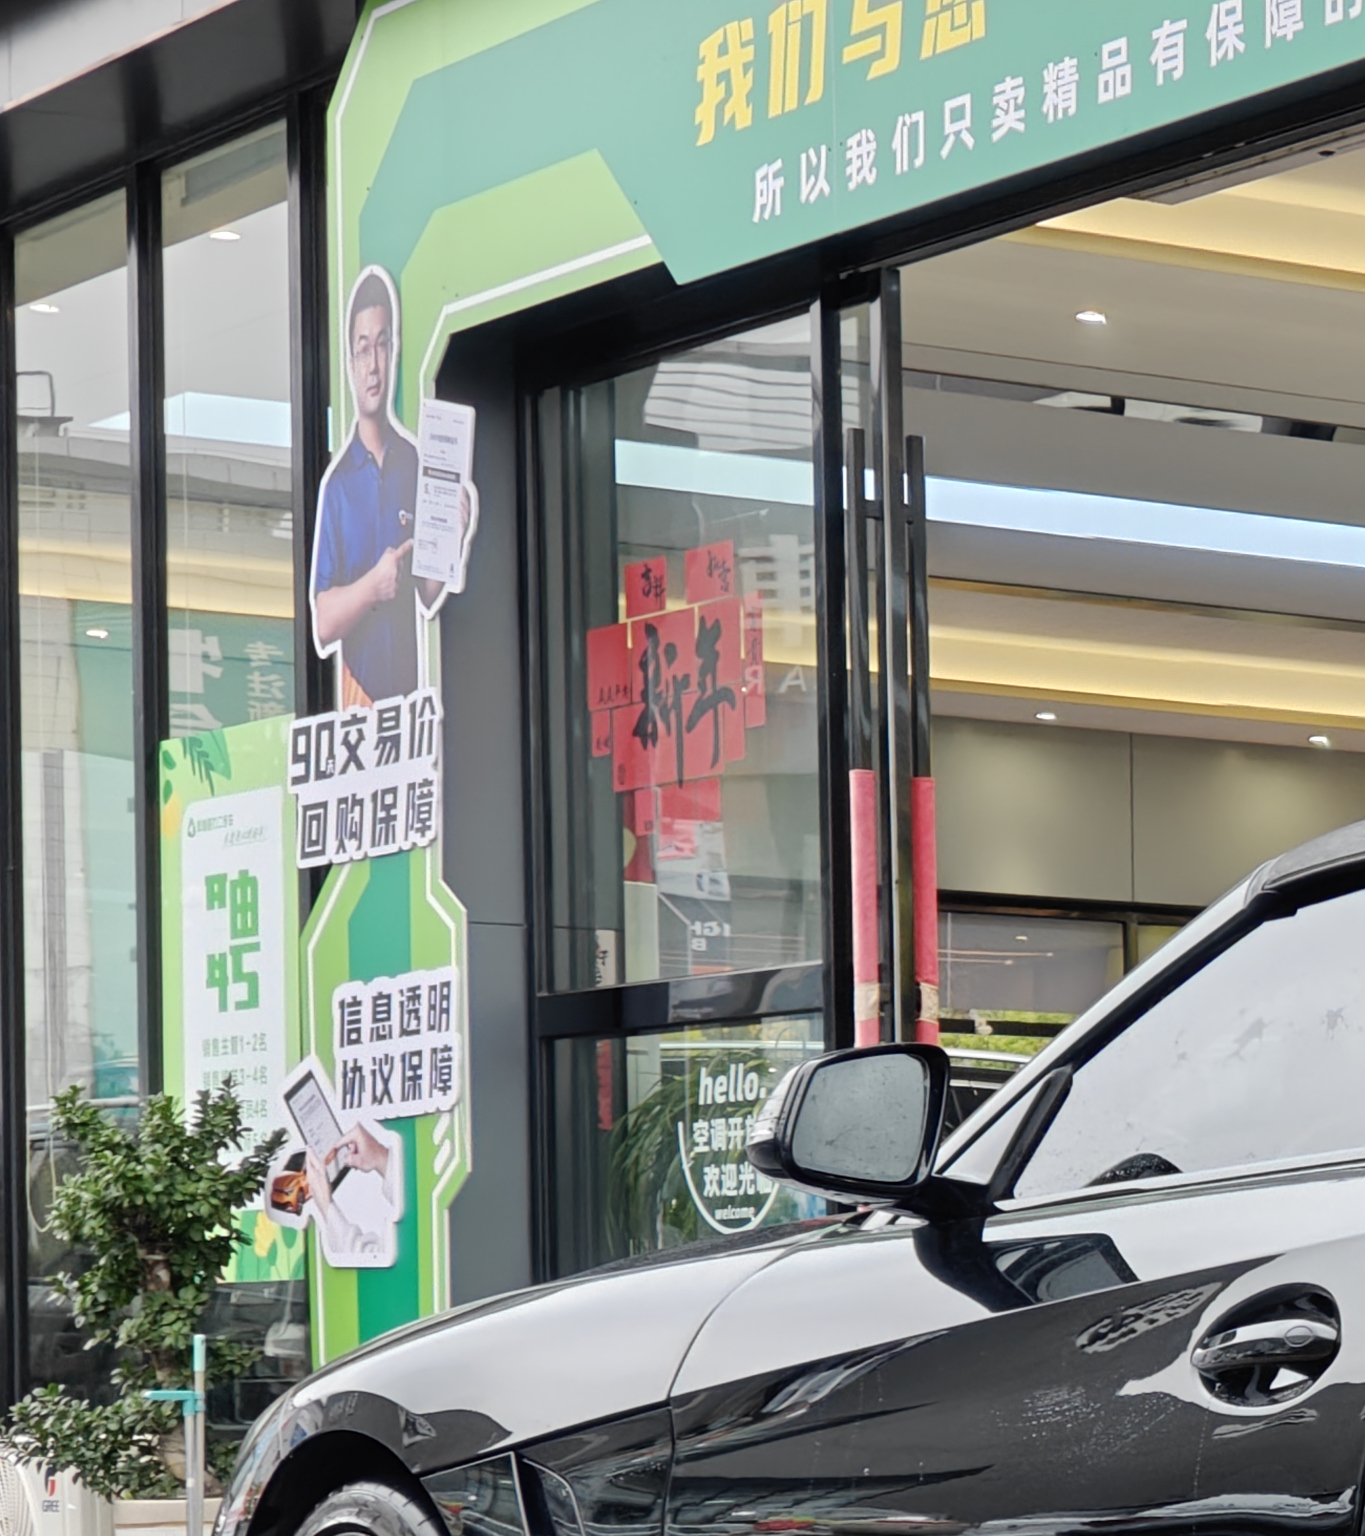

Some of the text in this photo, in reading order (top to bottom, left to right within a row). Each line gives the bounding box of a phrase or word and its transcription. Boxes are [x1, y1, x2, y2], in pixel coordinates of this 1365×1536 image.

[300, 777, 437, 861] 回购保障
[338, 980, 452, 1049] 信息透明
[341, 1044, 453, 1111] 协议保障
[714, 1204, 755, 1221] welcome
